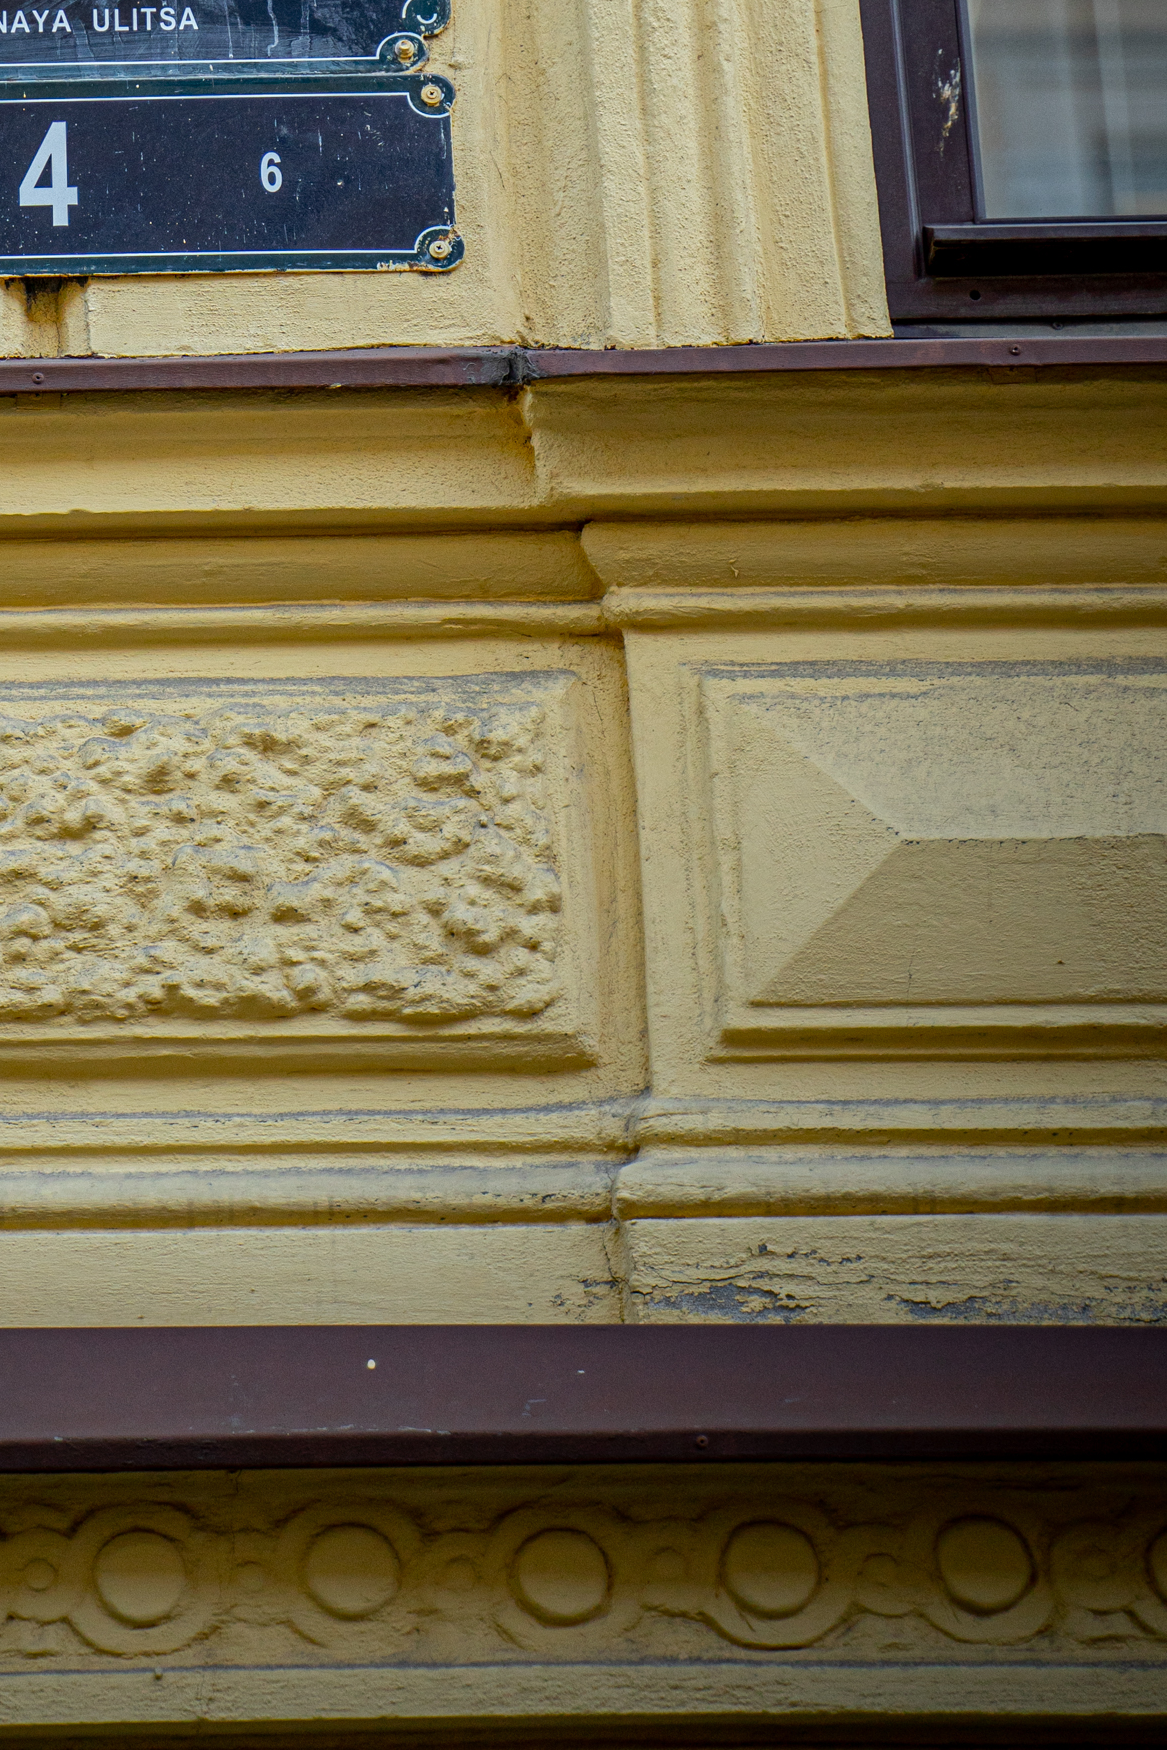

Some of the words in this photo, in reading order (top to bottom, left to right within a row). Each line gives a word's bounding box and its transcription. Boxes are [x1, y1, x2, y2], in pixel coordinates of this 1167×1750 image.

[91, 7, 199, 33] ULITSA
[18, 121, 79, 227] 4
[259, 151, 284, 194] 6
